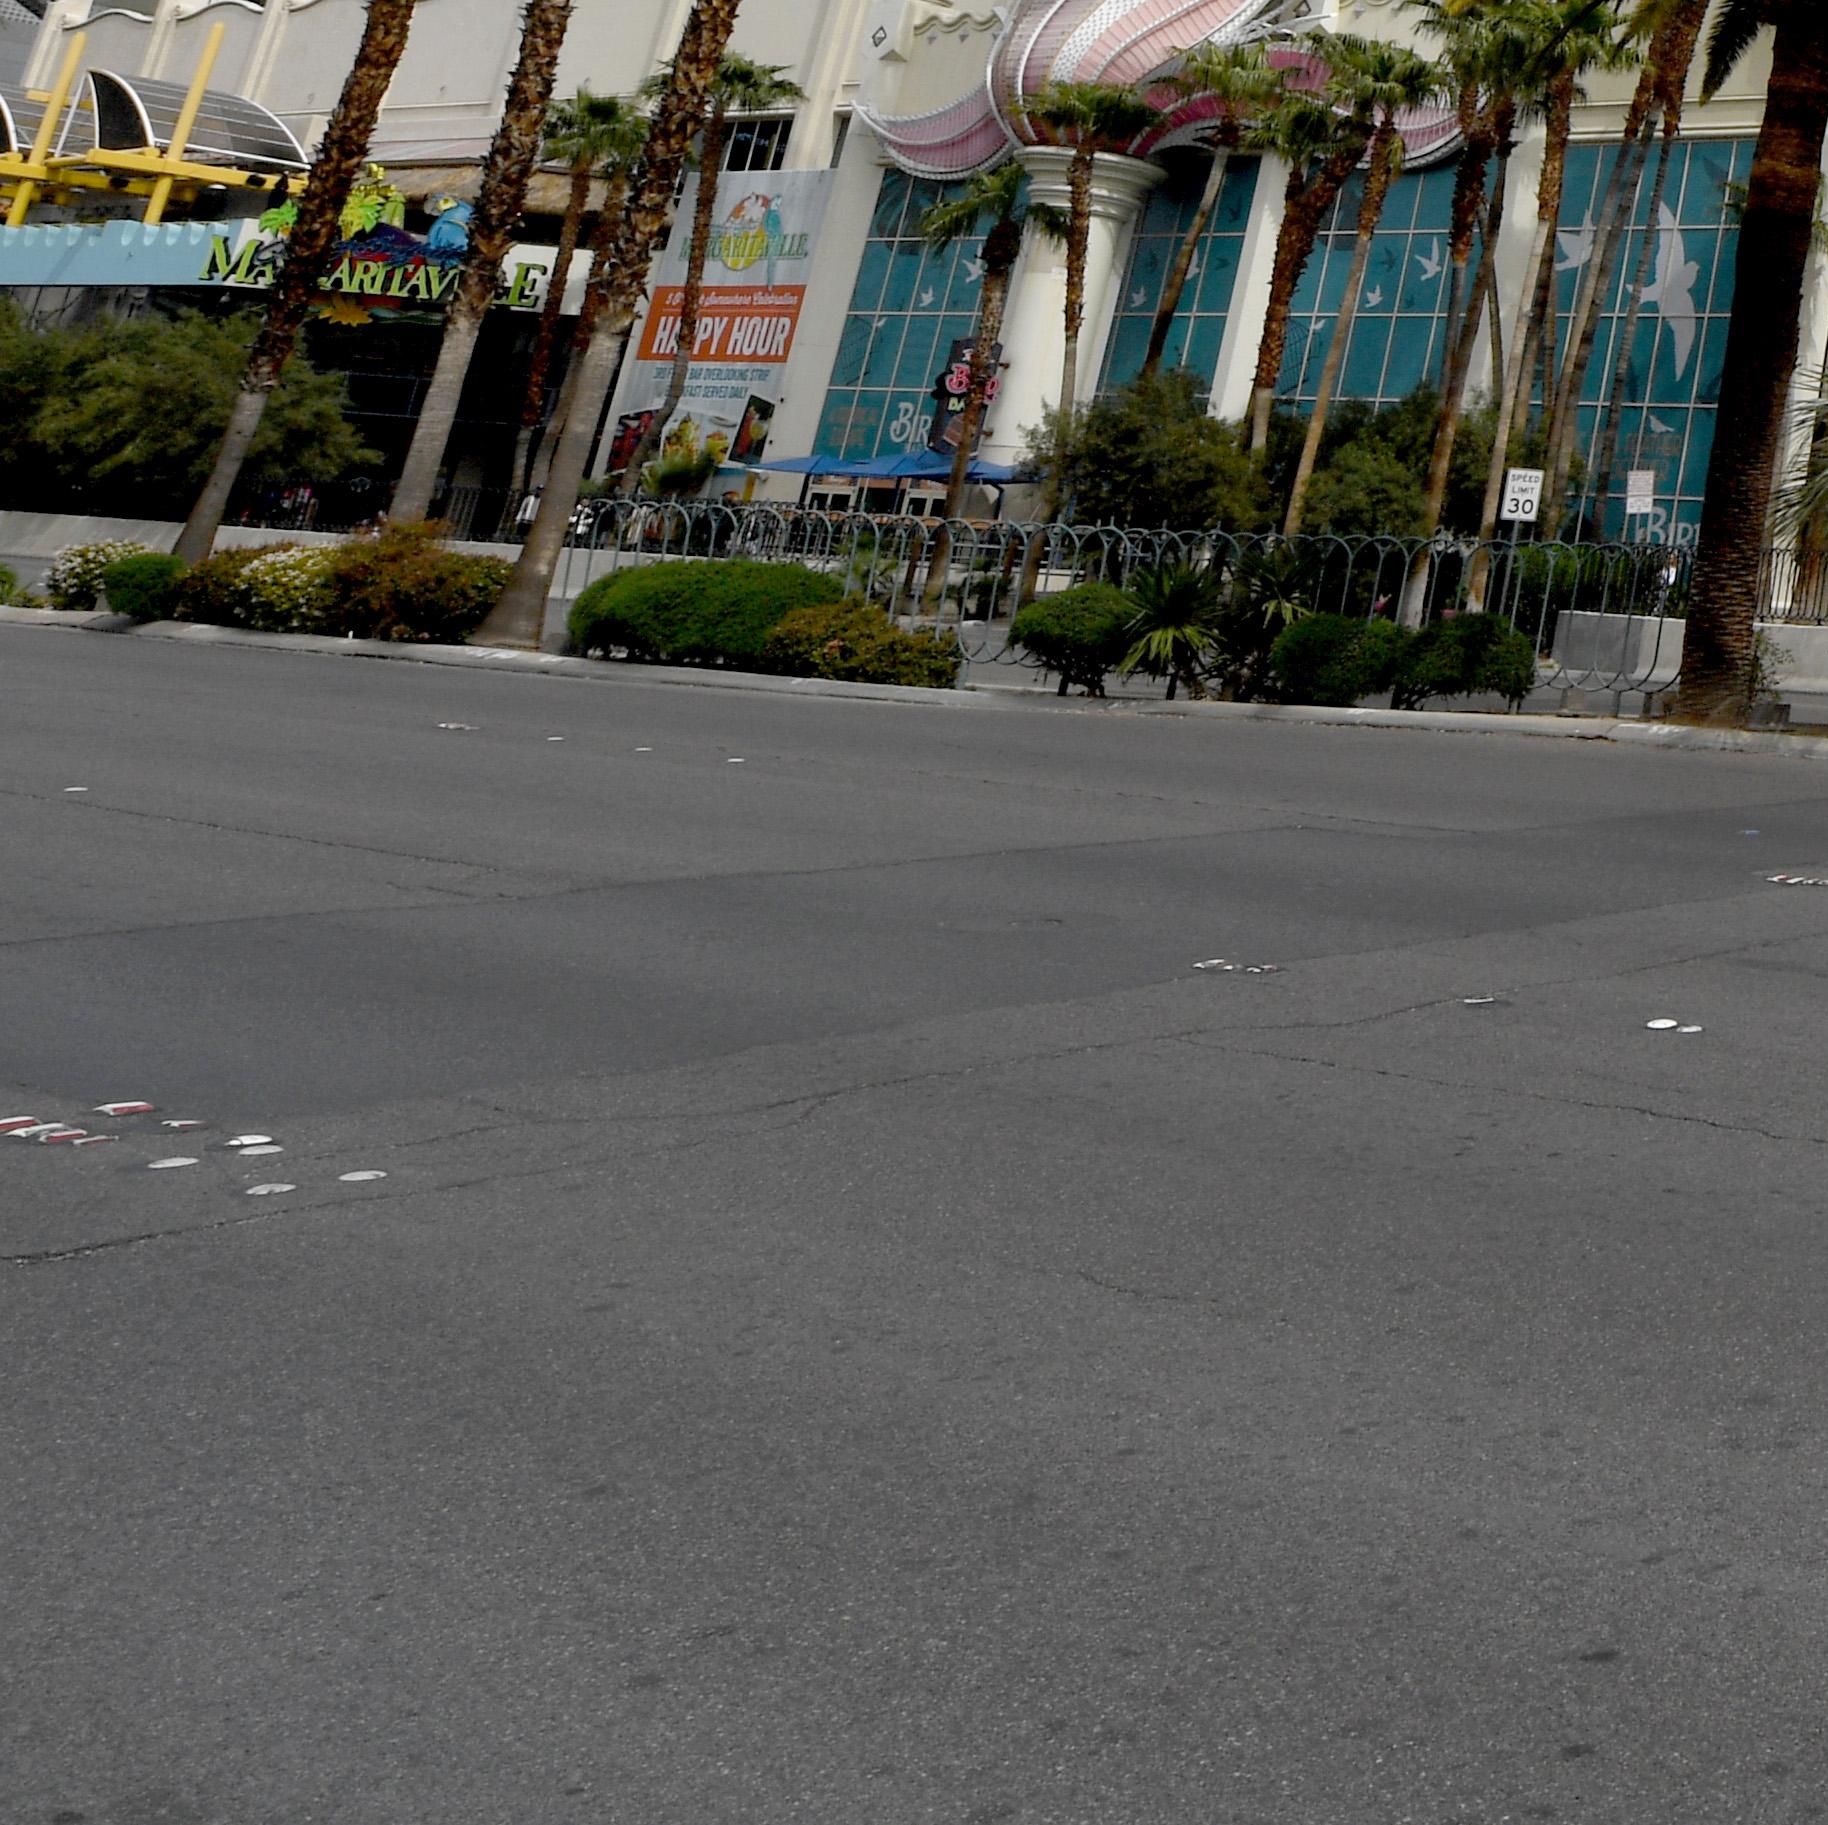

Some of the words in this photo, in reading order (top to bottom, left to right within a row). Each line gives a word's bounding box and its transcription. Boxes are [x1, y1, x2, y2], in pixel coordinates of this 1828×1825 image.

[651, 315, 729, 357] HAPY
[726, 315, 793, 357] HOUR
[1510, 473, 1541, 484] SPEED
[1511, 486, 1535, 495] LIMIT
[1507, 497, 1534, 515] 30
